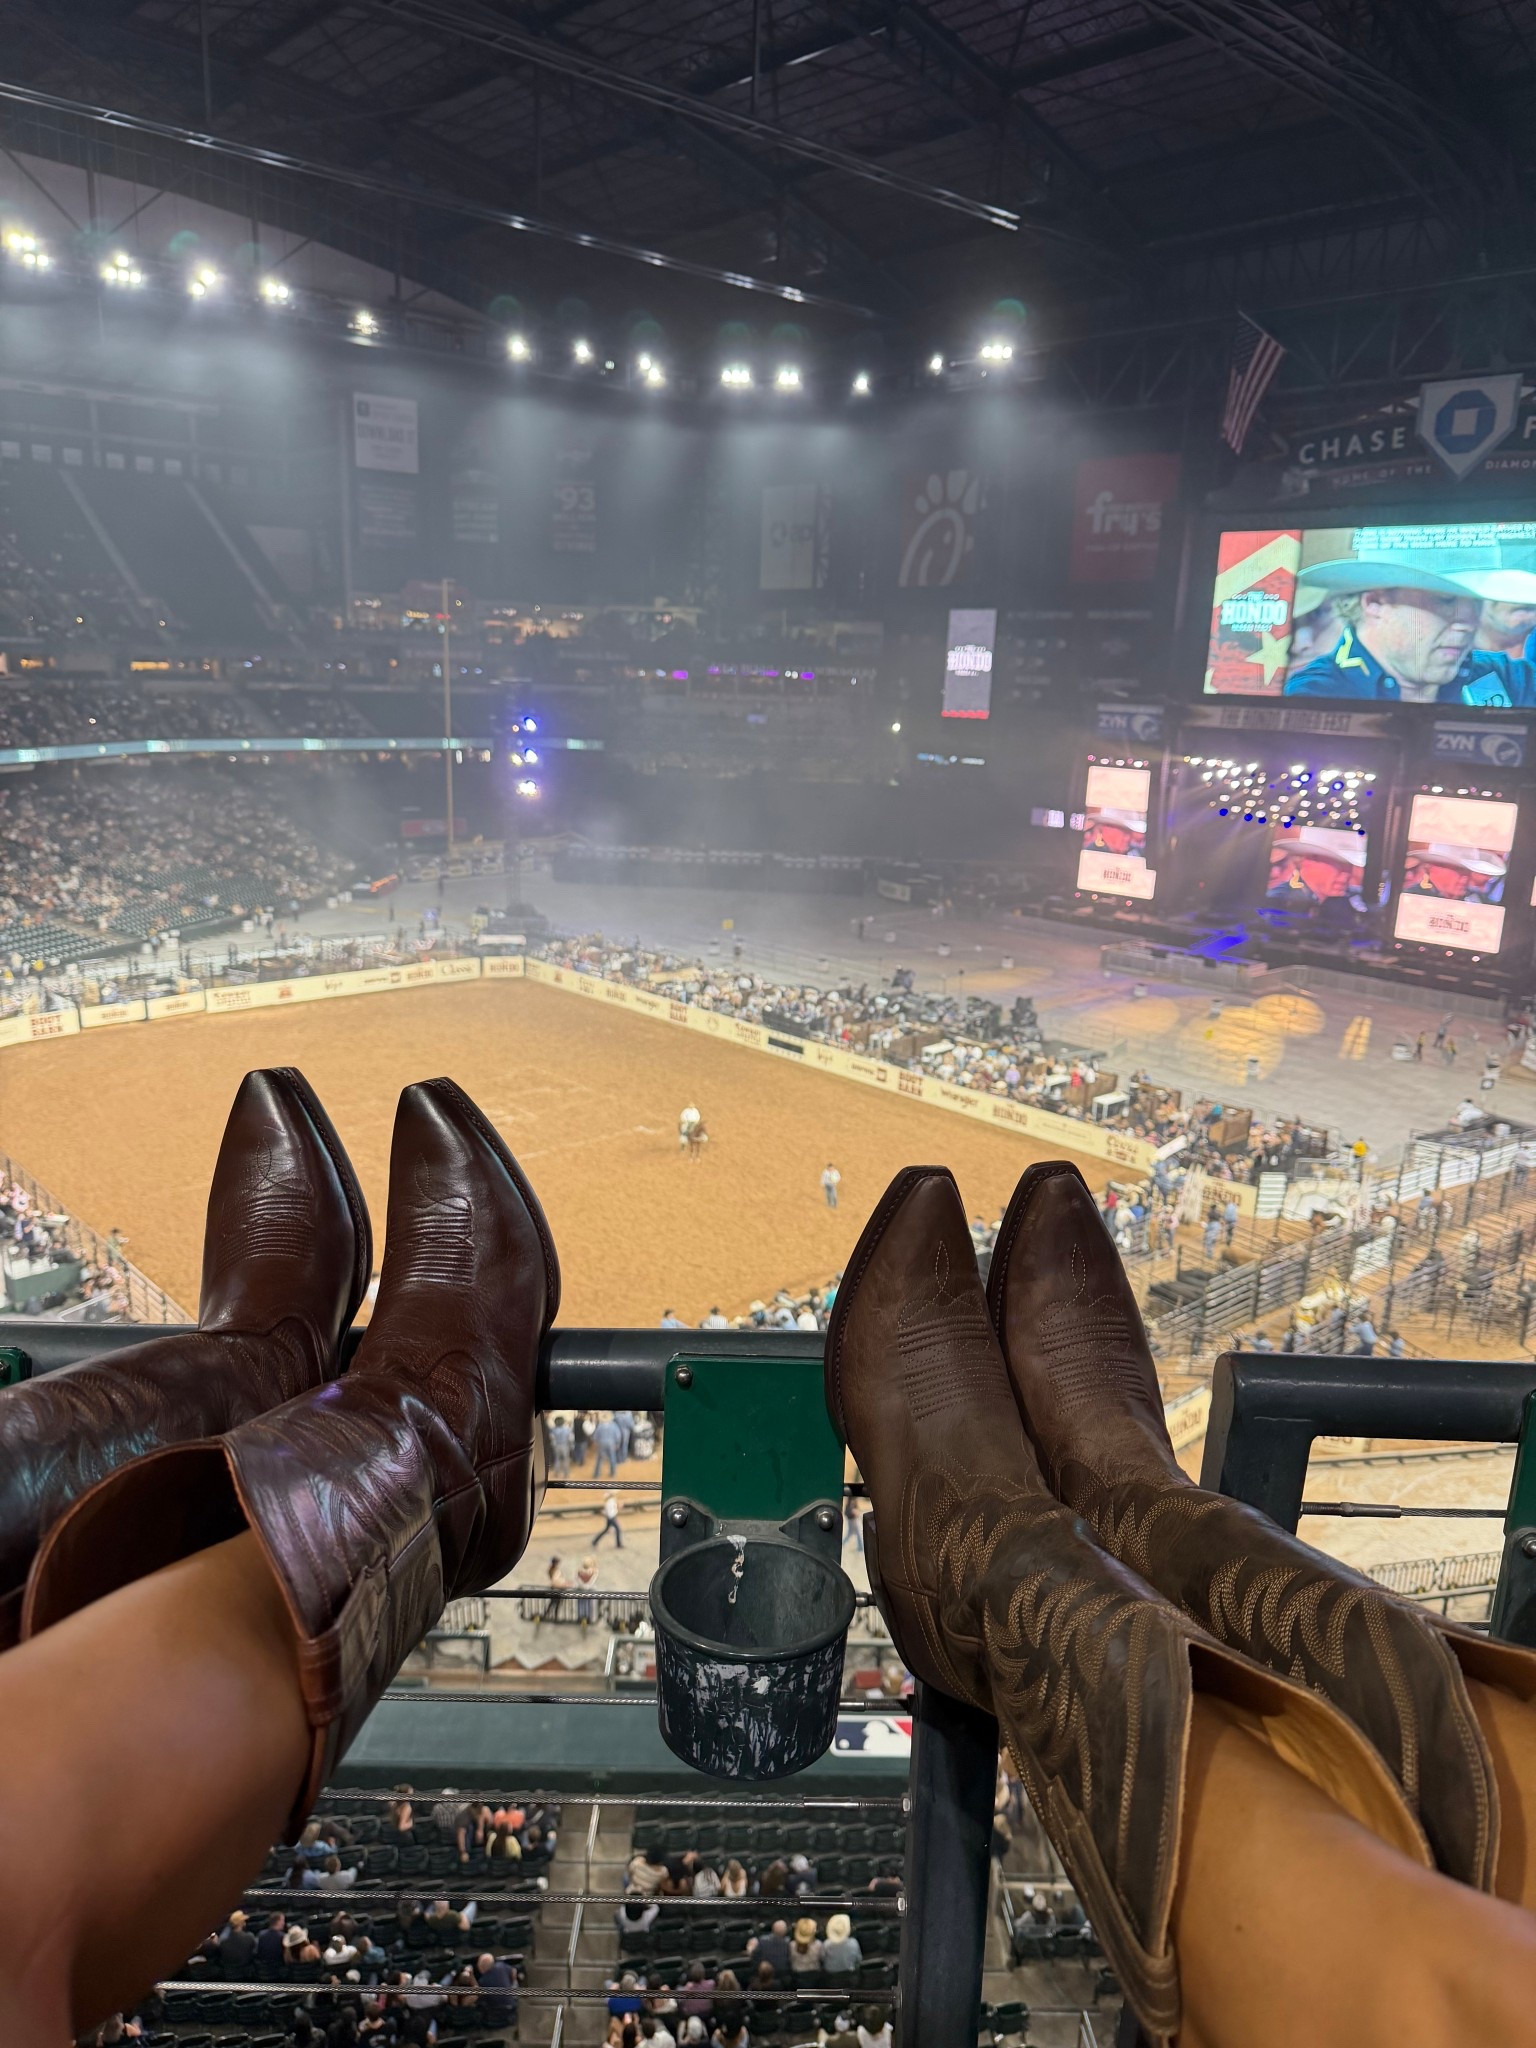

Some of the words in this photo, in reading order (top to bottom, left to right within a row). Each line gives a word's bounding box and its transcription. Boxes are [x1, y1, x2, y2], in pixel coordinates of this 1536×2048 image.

[1299, 427, 1406, 464] CHASE
[1406, 465, 1432, 477] THE
[1086, 491, 1162, 536] fry's
[1220, 600, 1288, 625] HONDO
[1098, 713, 1128, 728] ZYN
[1436, 733, 1476, 752] ZYN
